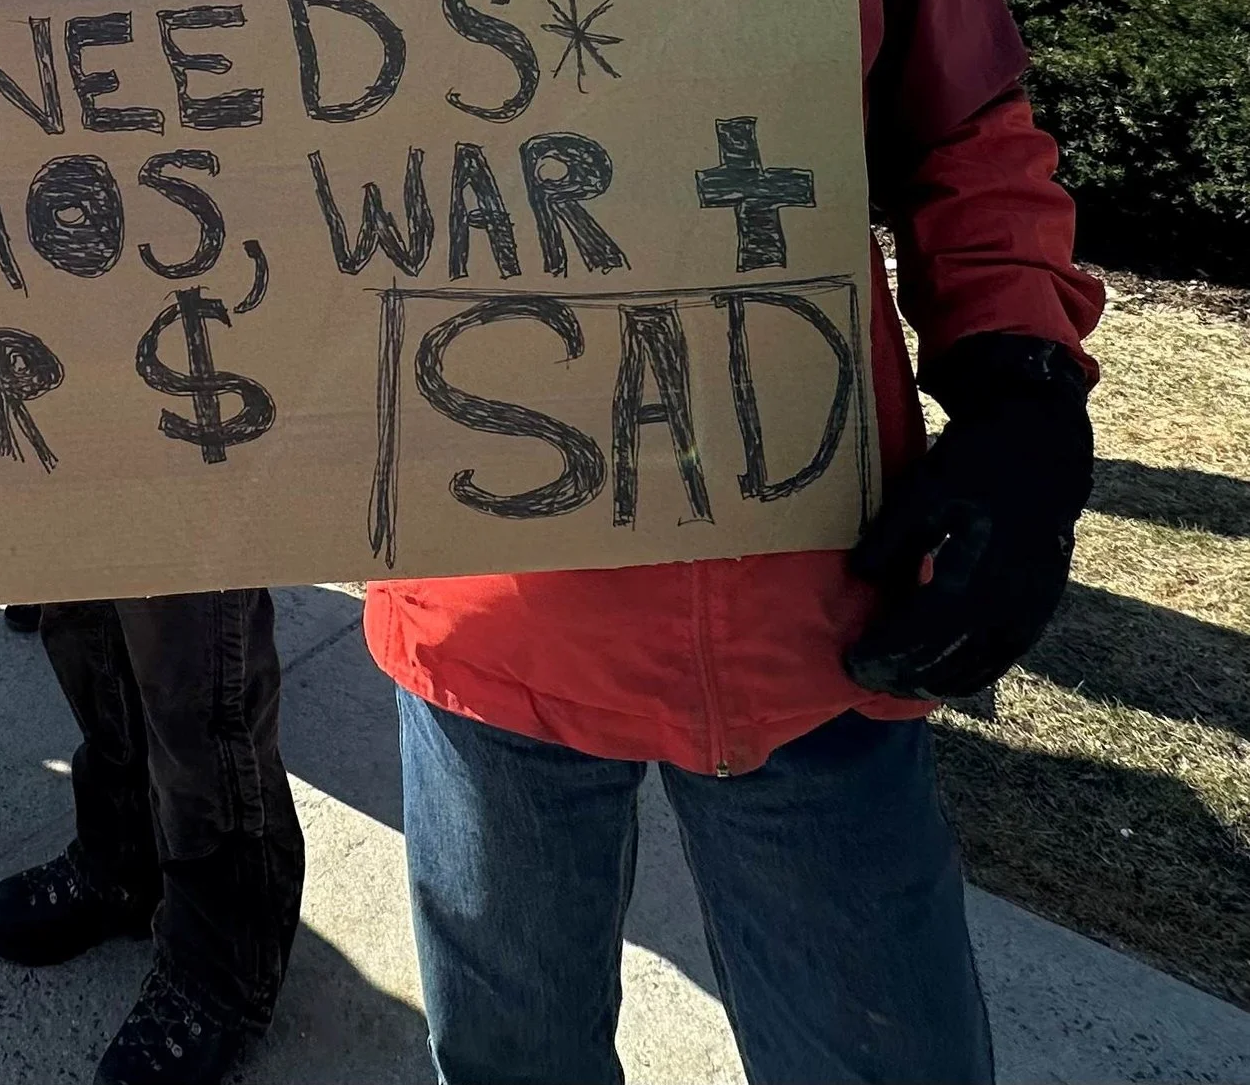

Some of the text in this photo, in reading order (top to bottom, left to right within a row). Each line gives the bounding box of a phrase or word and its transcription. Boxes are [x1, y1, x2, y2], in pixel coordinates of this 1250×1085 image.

[308, 132, 632, 279] WAR
[136, 284, 276, 464] $
[415, 293, 854, 532] SAD
